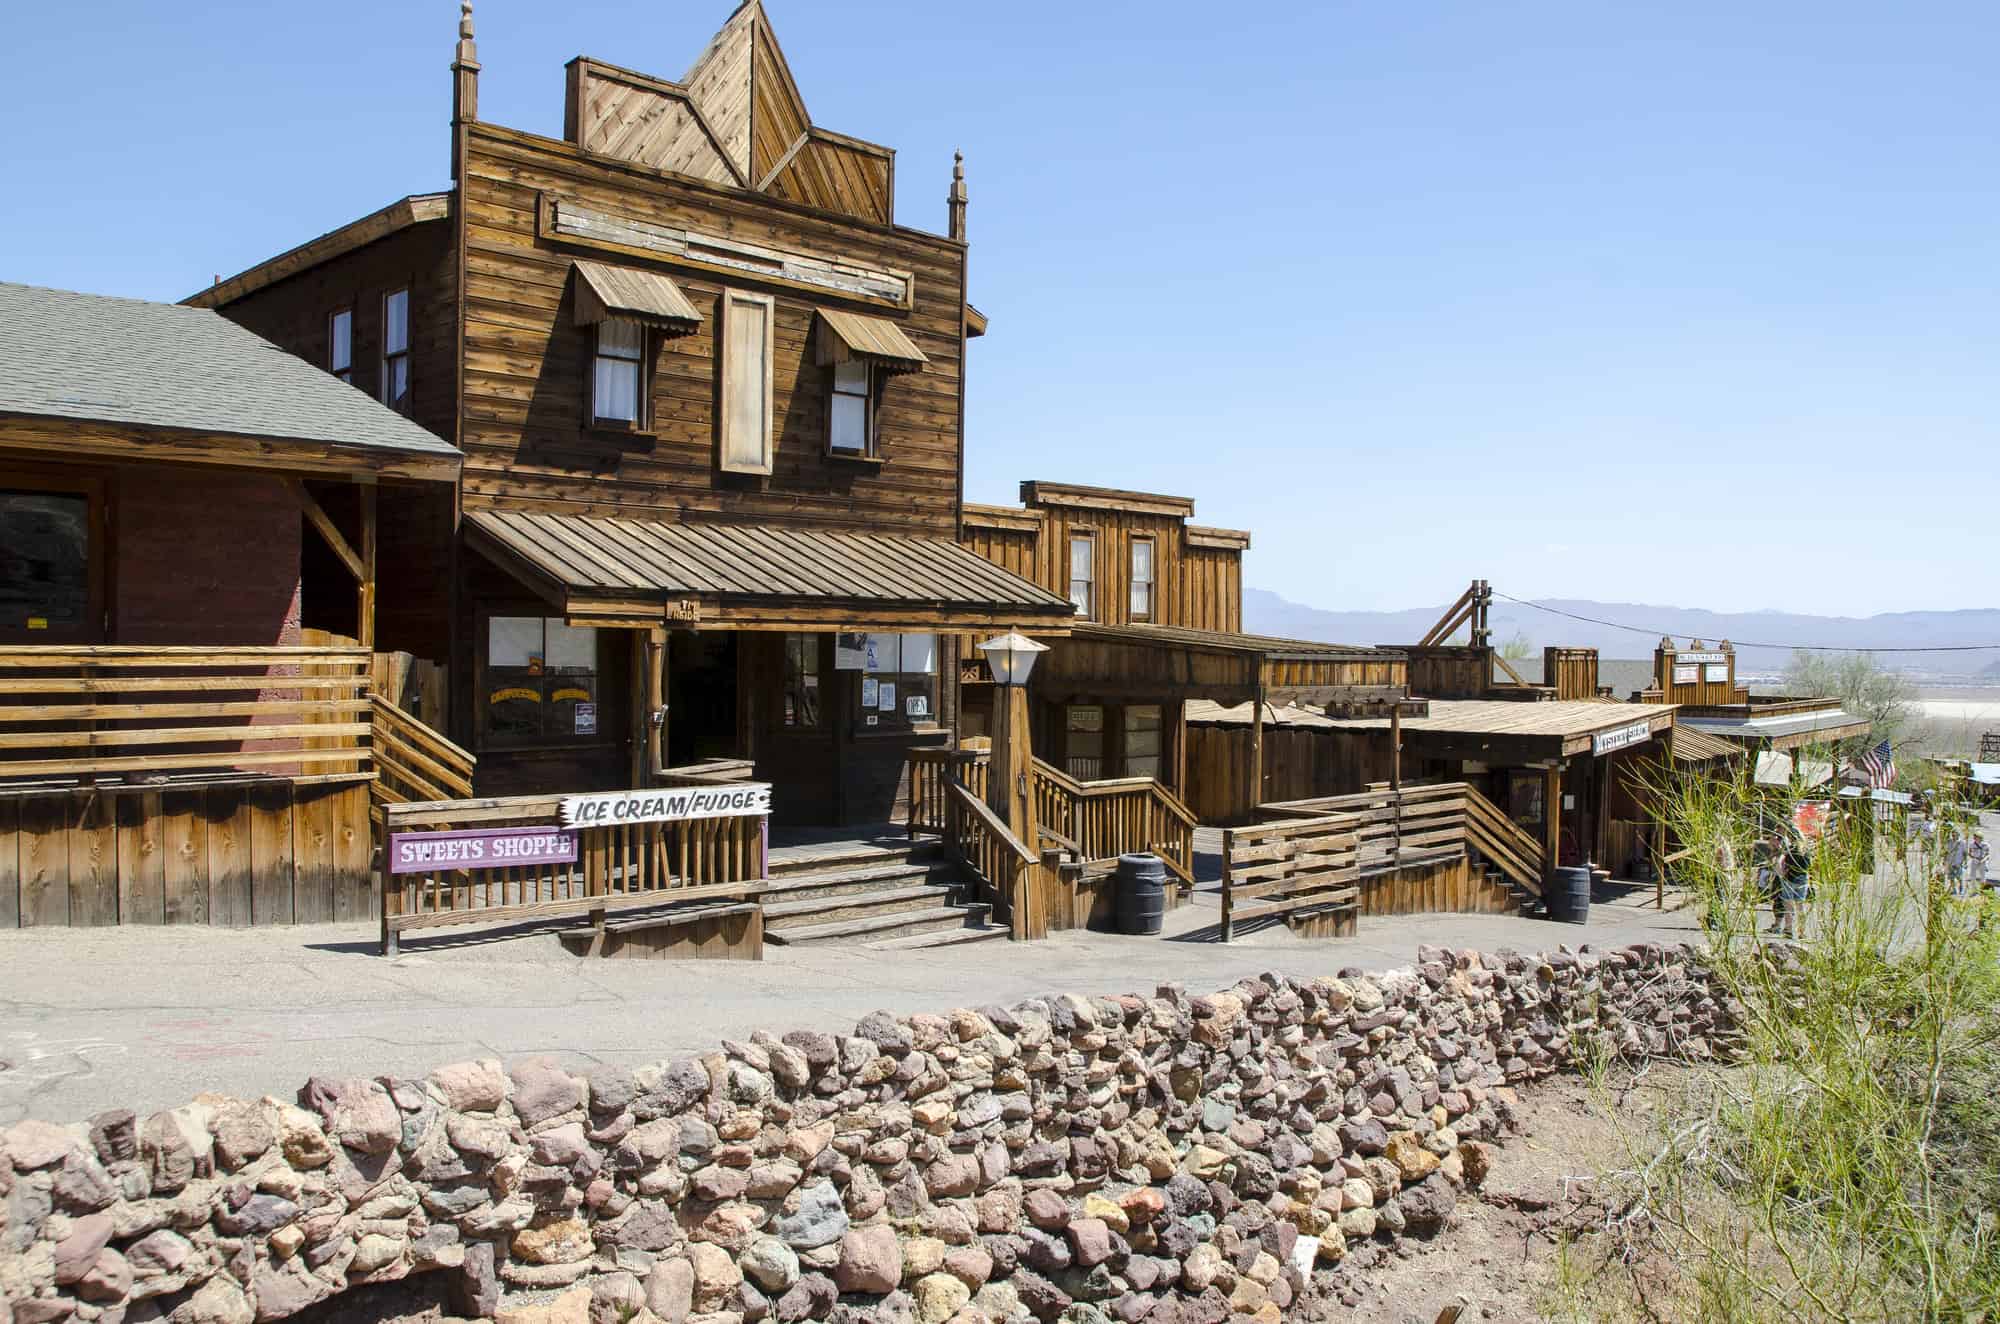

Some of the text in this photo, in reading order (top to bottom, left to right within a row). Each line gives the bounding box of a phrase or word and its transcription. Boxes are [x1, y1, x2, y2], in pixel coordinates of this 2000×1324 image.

[908, 697, 926, 713] OPEN
[575, 791, 756, 822] ICE CREAM/FUDGE
[400, 835, 571, 863] SWEETS SHOPPE
